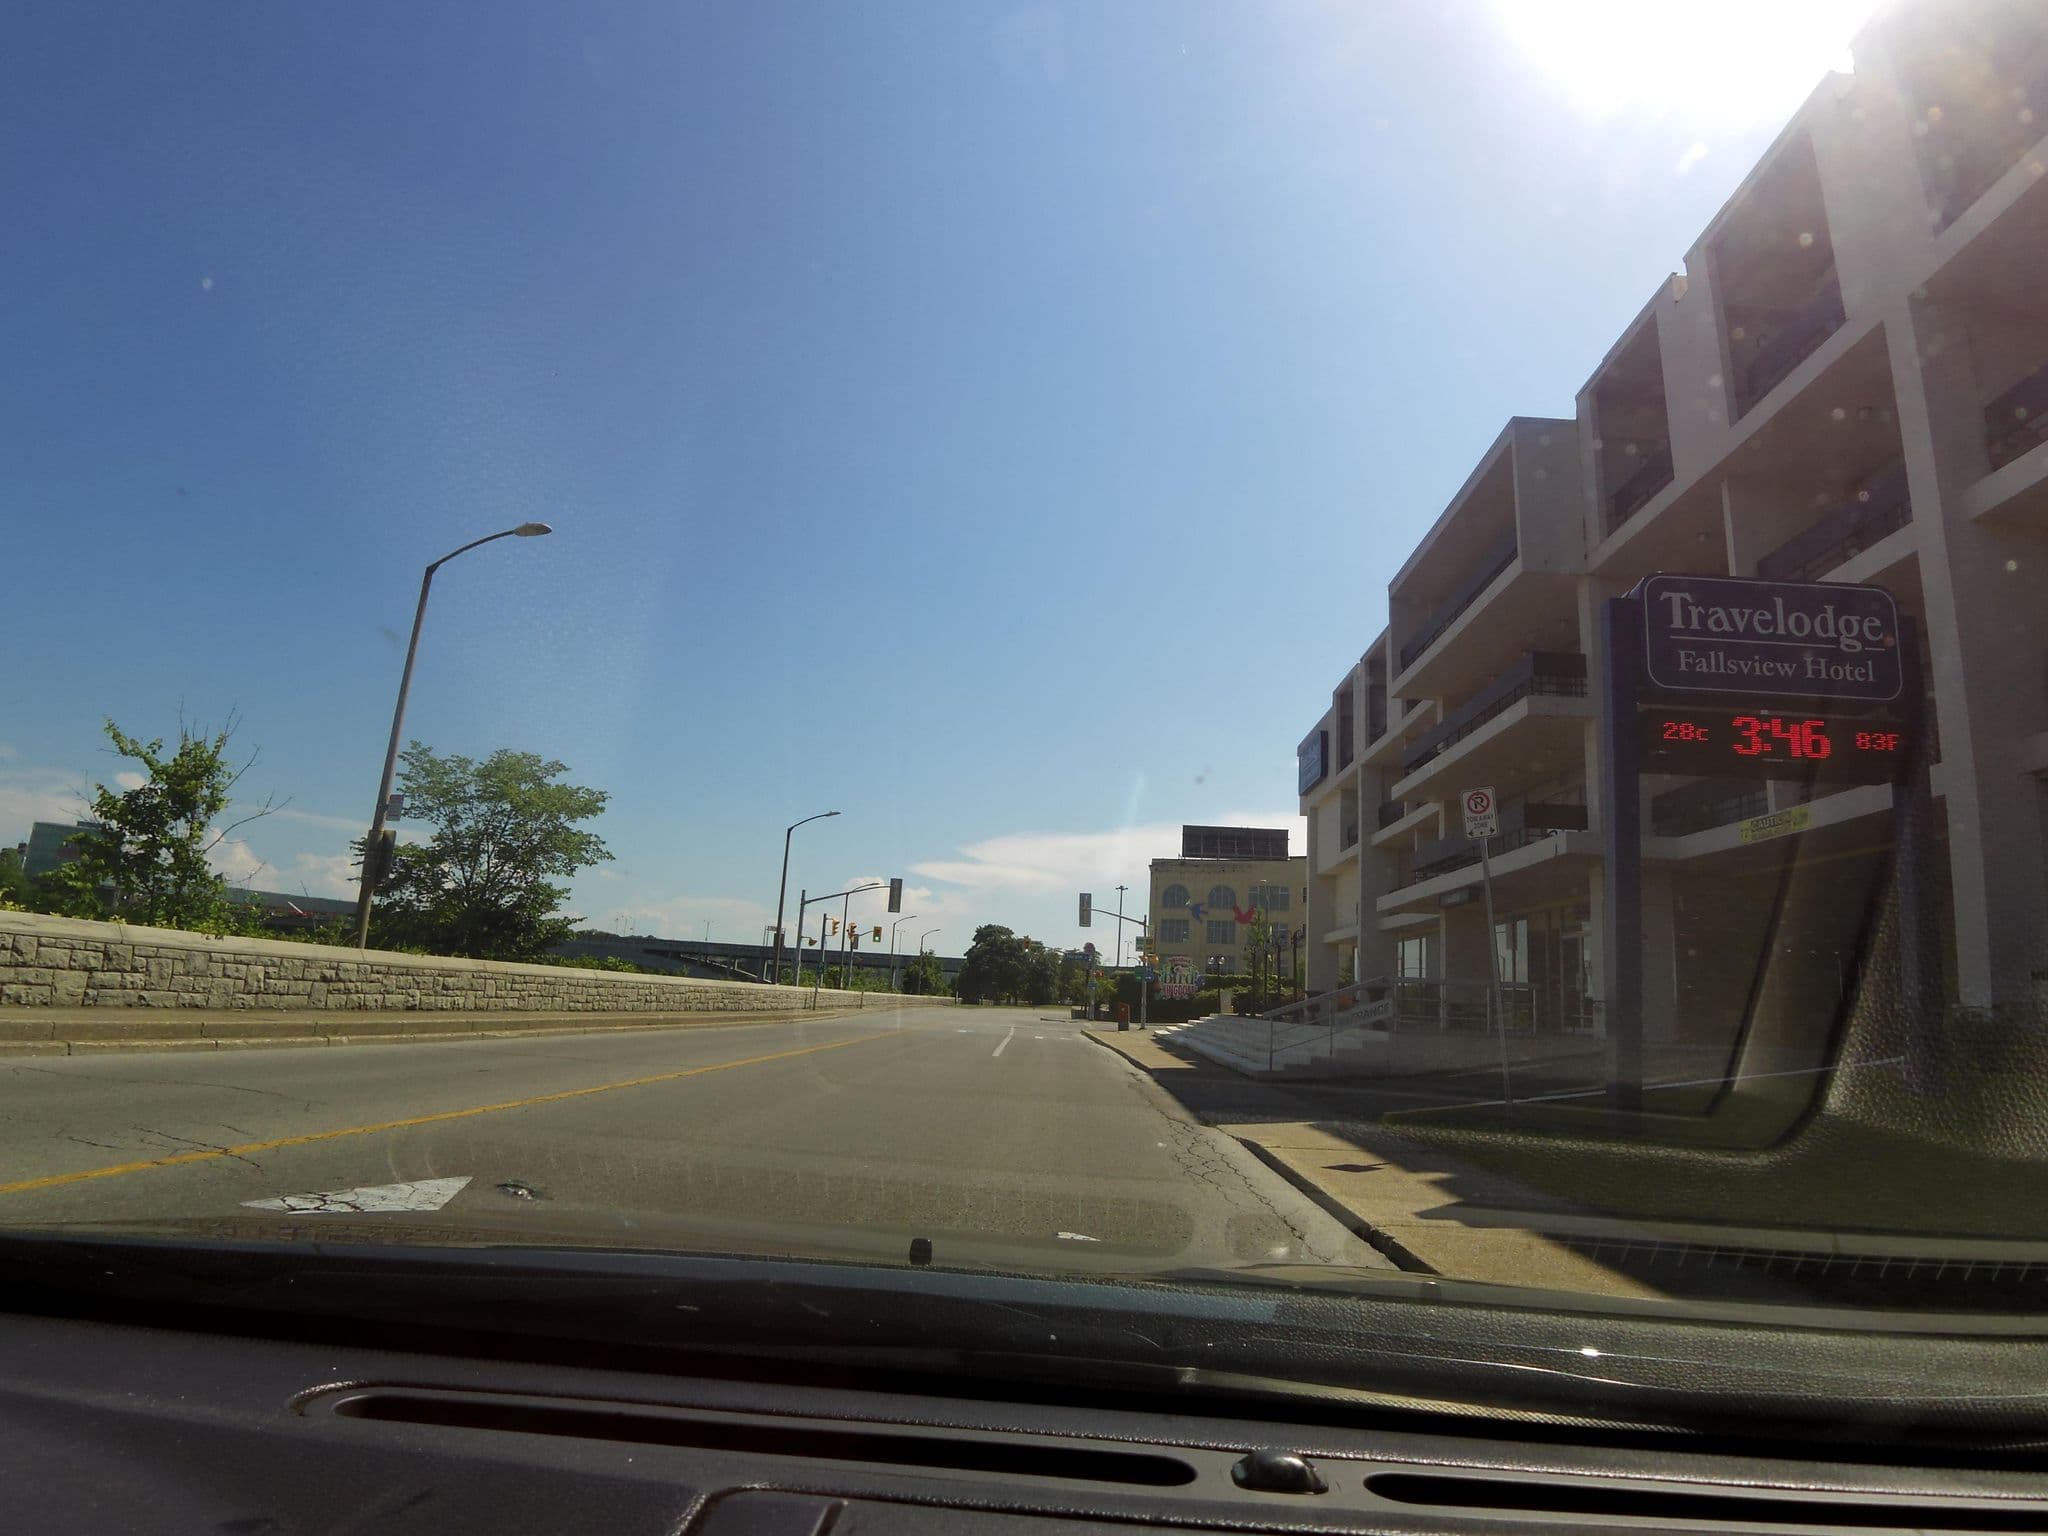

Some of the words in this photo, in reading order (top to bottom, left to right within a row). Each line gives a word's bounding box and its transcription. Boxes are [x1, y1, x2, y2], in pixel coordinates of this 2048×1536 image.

[1660, 591, 1885, 652] Travelodge
[1678, 650, 1797, 678] Fallsview
[1805, 656, 1877, 683] Hotel
[1732, 716, 1832, 759] 3:46
[1855, 732, 1900, 751] 83F
